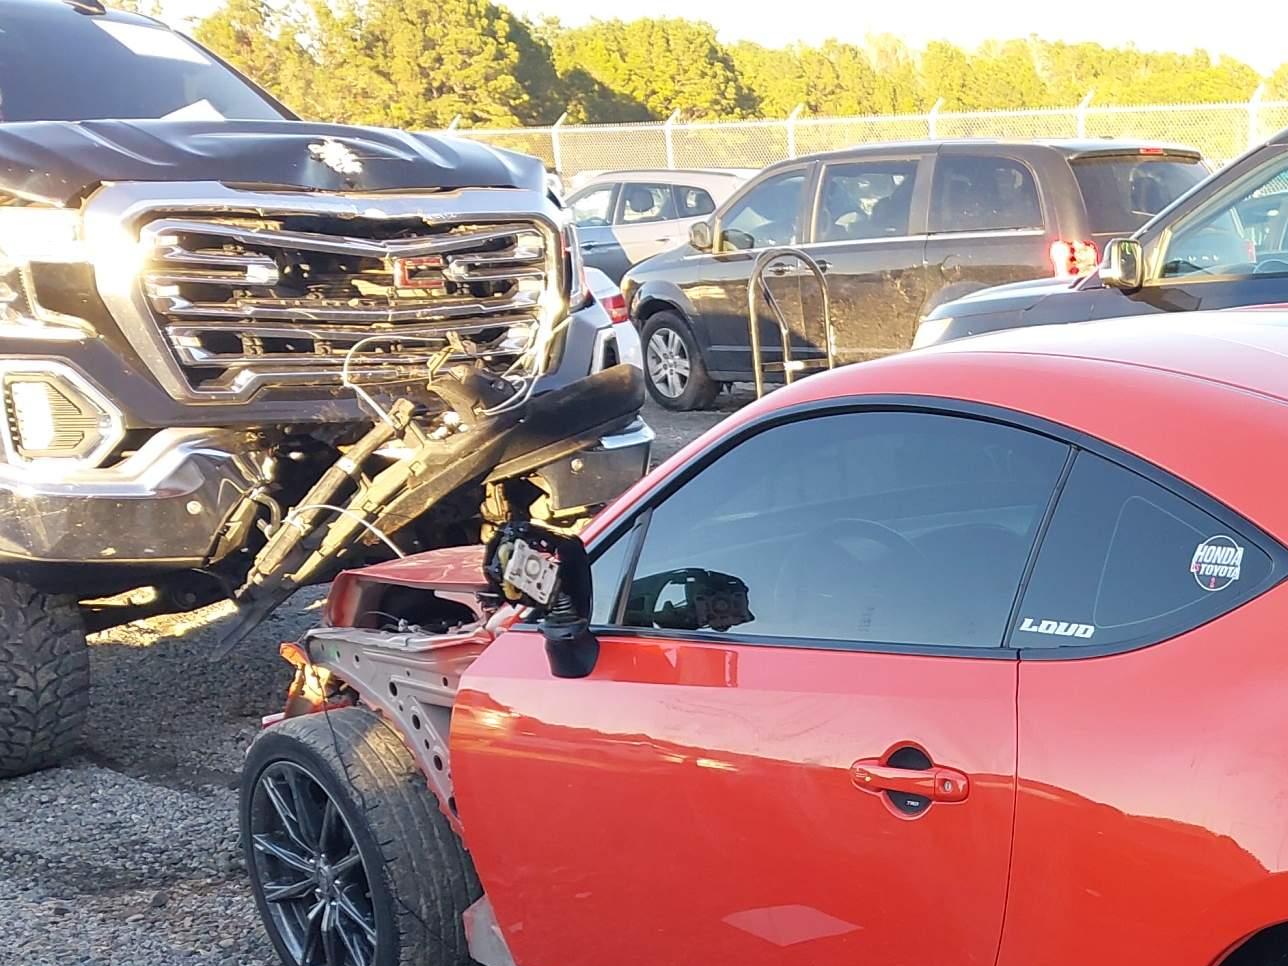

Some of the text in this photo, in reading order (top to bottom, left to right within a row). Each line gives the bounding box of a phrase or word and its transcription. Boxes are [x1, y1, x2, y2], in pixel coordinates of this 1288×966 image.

[1194, 544, 1244, 566] HONDA
[1199, 563, 1241, 580] TOYOTA
[1020, 617, 1095, 639] LOUD
